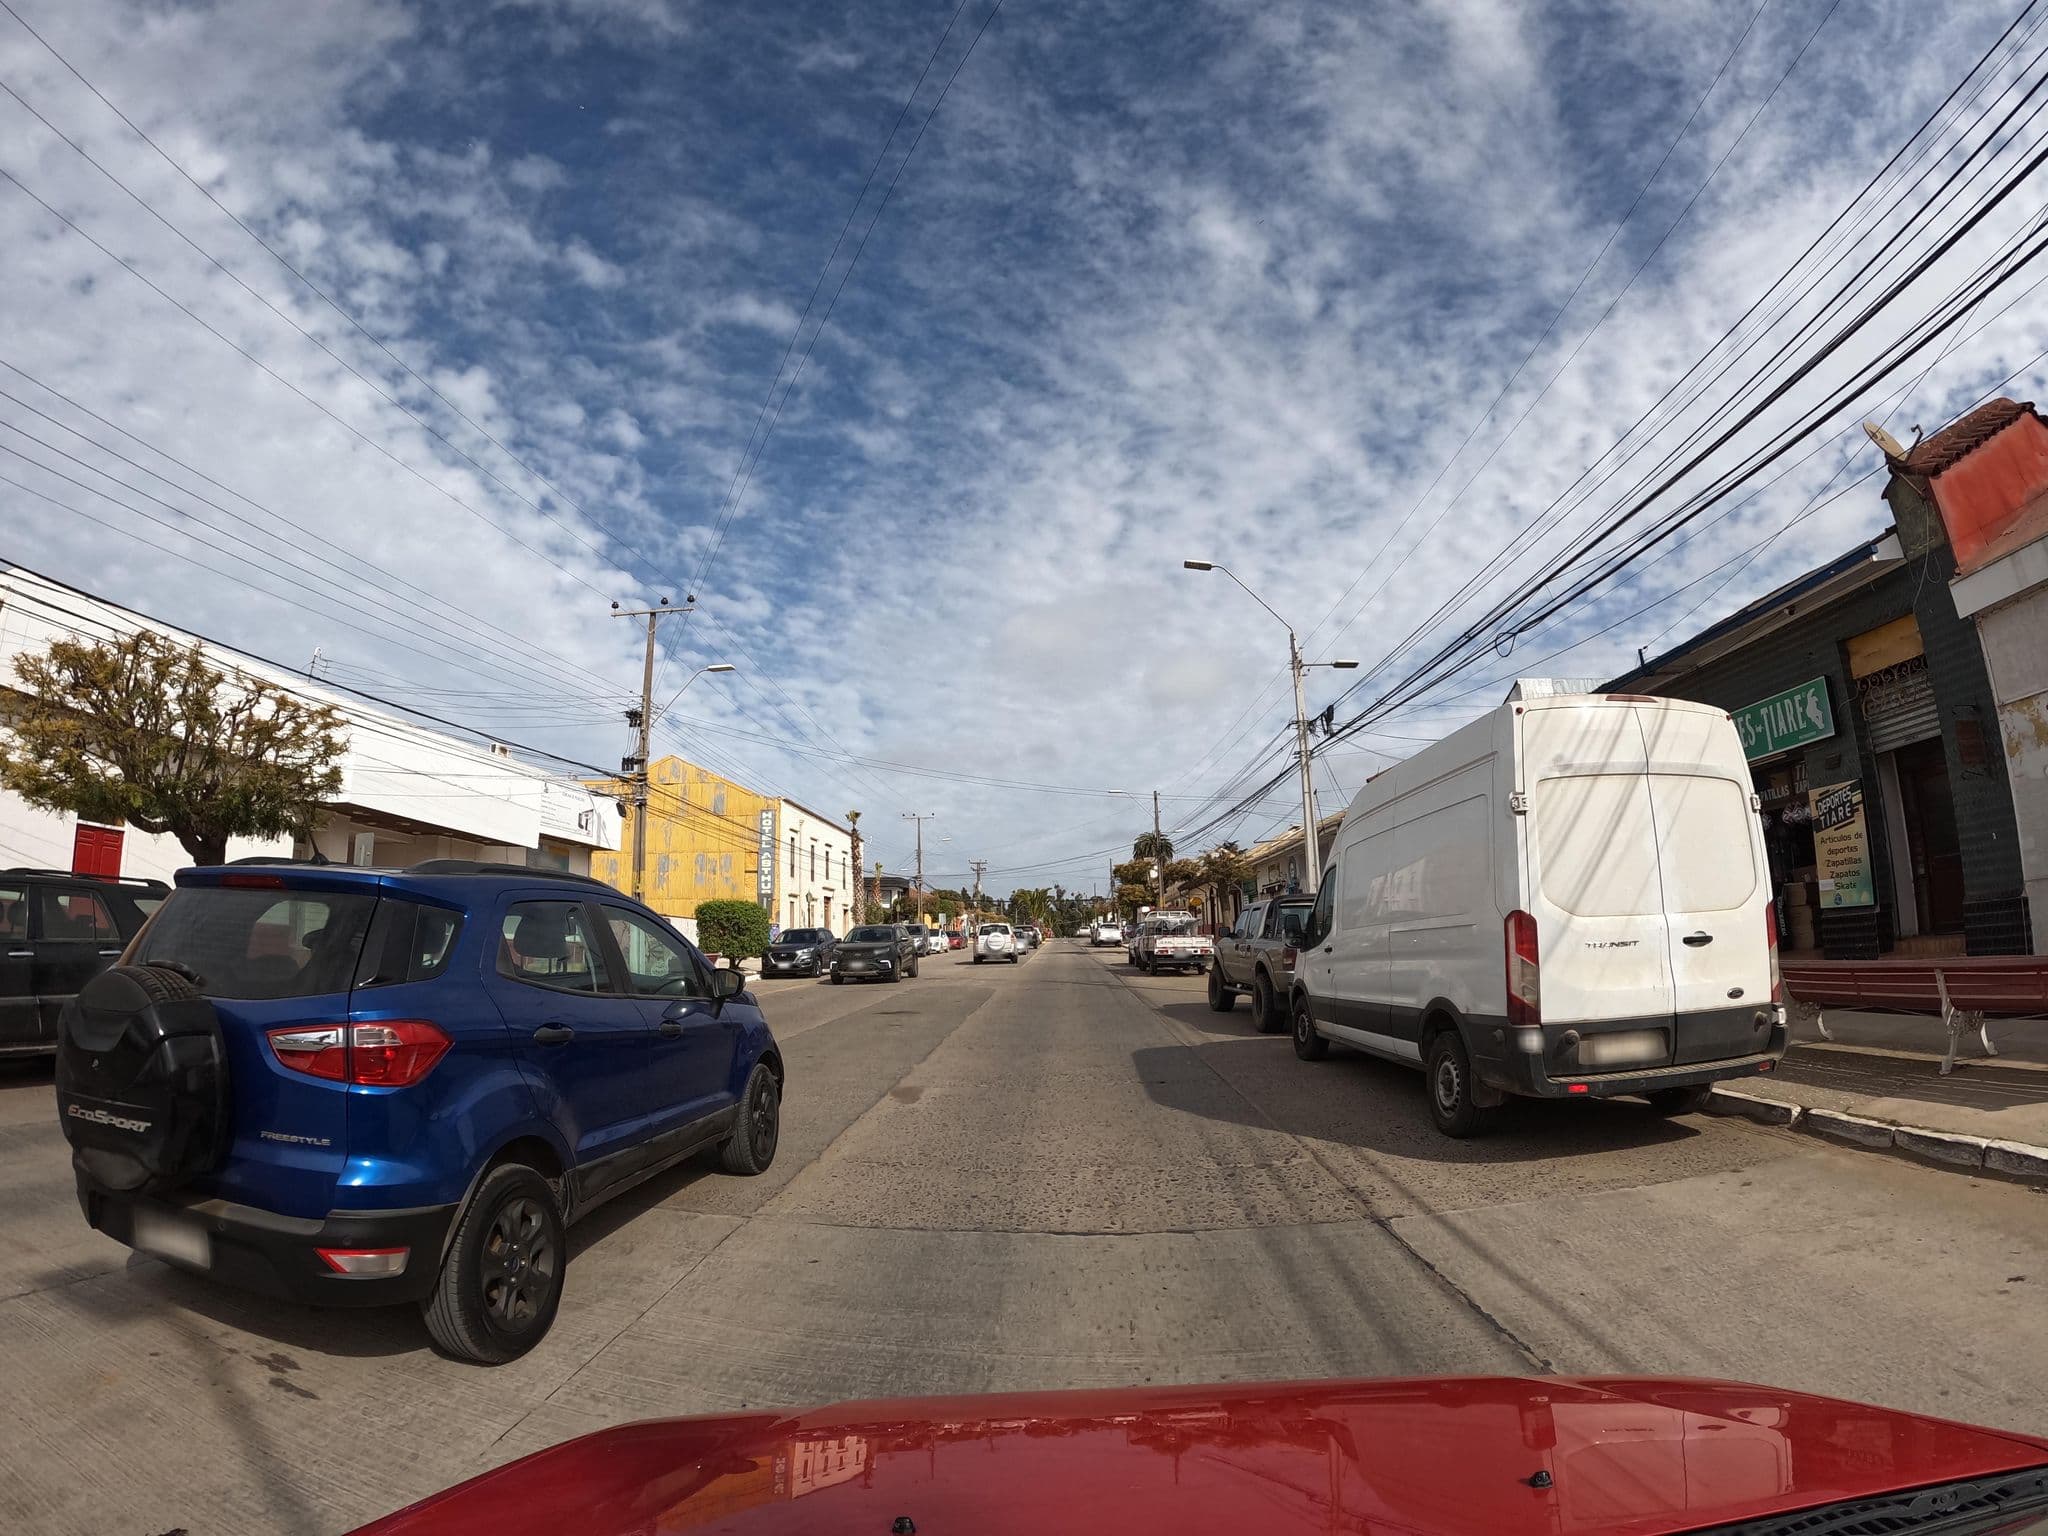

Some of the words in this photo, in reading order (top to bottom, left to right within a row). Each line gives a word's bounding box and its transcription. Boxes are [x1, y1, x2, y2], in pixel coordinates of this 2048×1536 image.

[1760, 694, 1806, 751] TIARE
[1817, 786, 1852, 815] DEPORTES
[1820, 805, 1852, 829] TIARE
[761, 811, 773, 848] HOTEL
[1854, 831, 1865, 840] de
[1827, 845, 1859, 856] deportes
[1826, 856, 1862, 868] Zapatillas
[1830, 869, 1861, 879] Zapatos
[1834, 880, 1857, 890] Skate
[1584, 940, 1640, 949] TRANSIT
[260, 1130, 332, 1146] FREESTYLE
